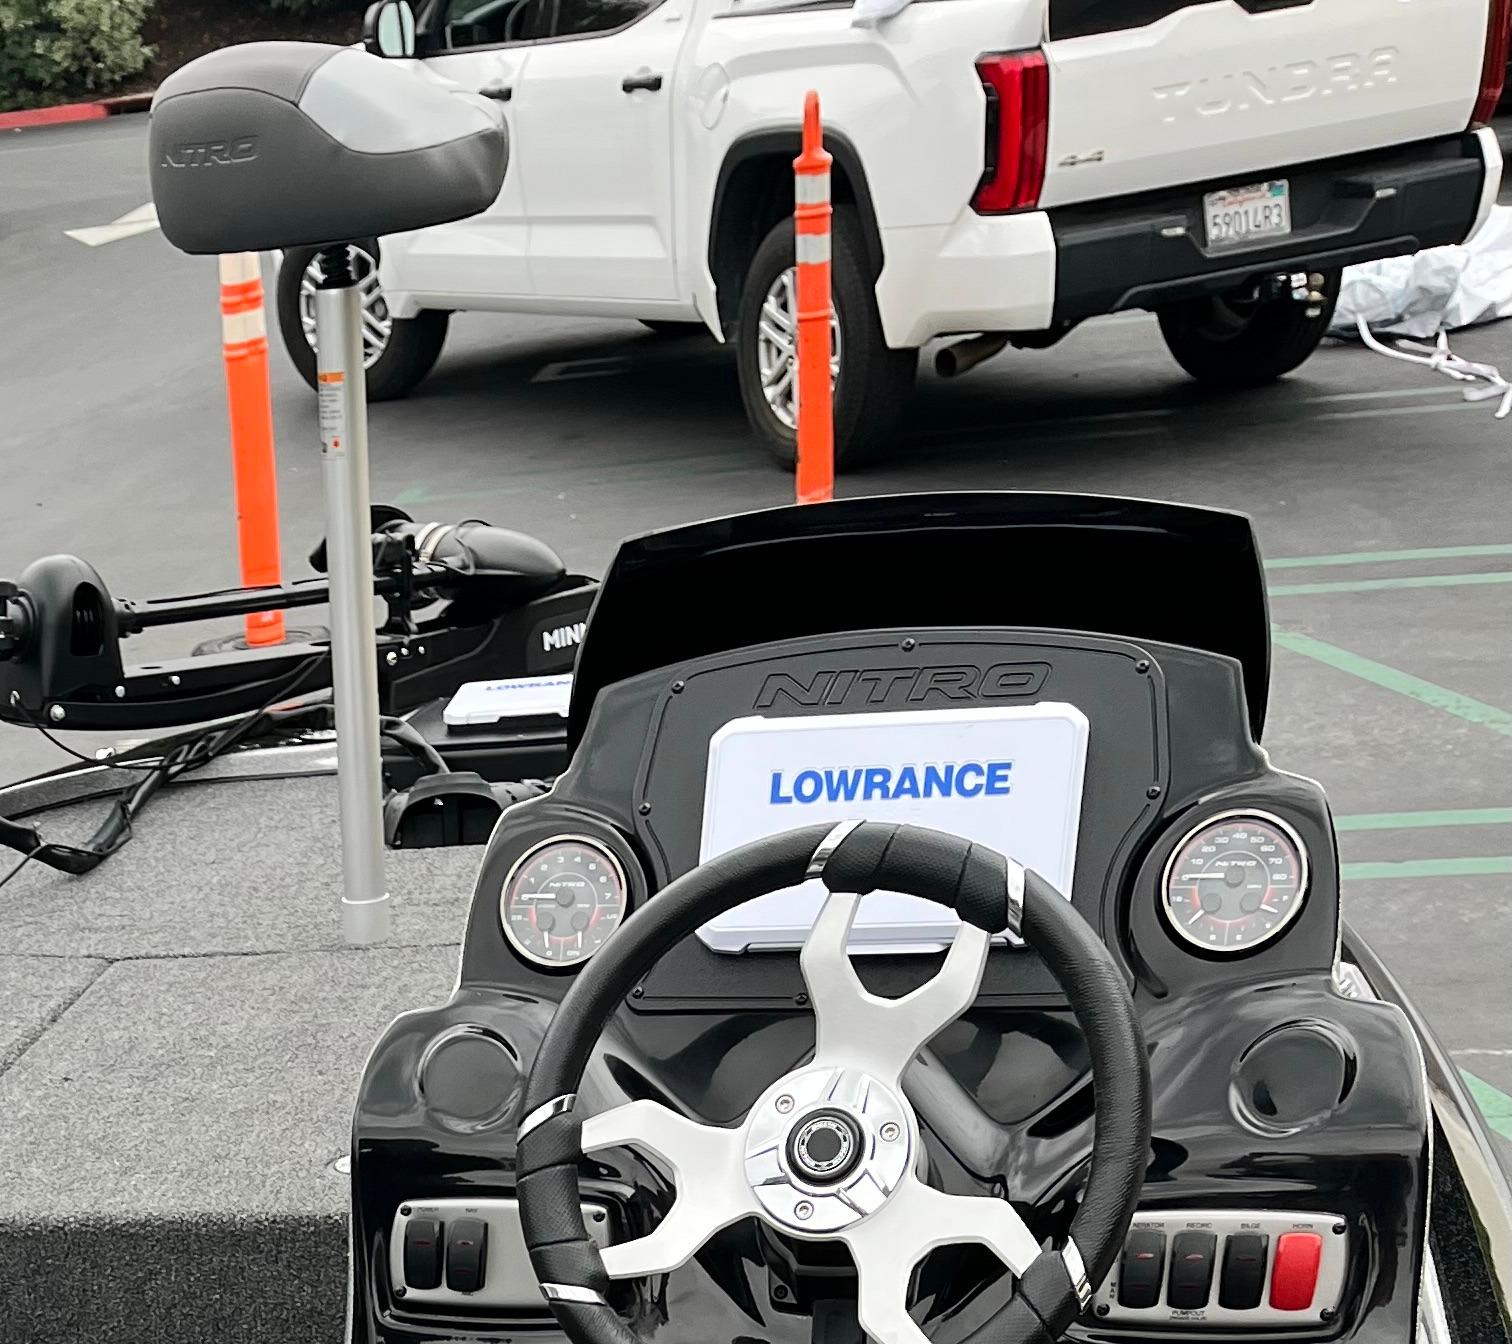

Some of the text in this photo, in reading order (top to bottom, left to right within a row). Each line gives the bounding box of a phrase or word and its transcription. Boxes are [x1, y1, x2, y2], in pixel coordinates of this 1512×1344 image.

[1151, 45, 1401, 122] TUNDRA
[752, 661, 1053, 709] NITRO
[769, 761, 1013, 804] LOWRANCE
